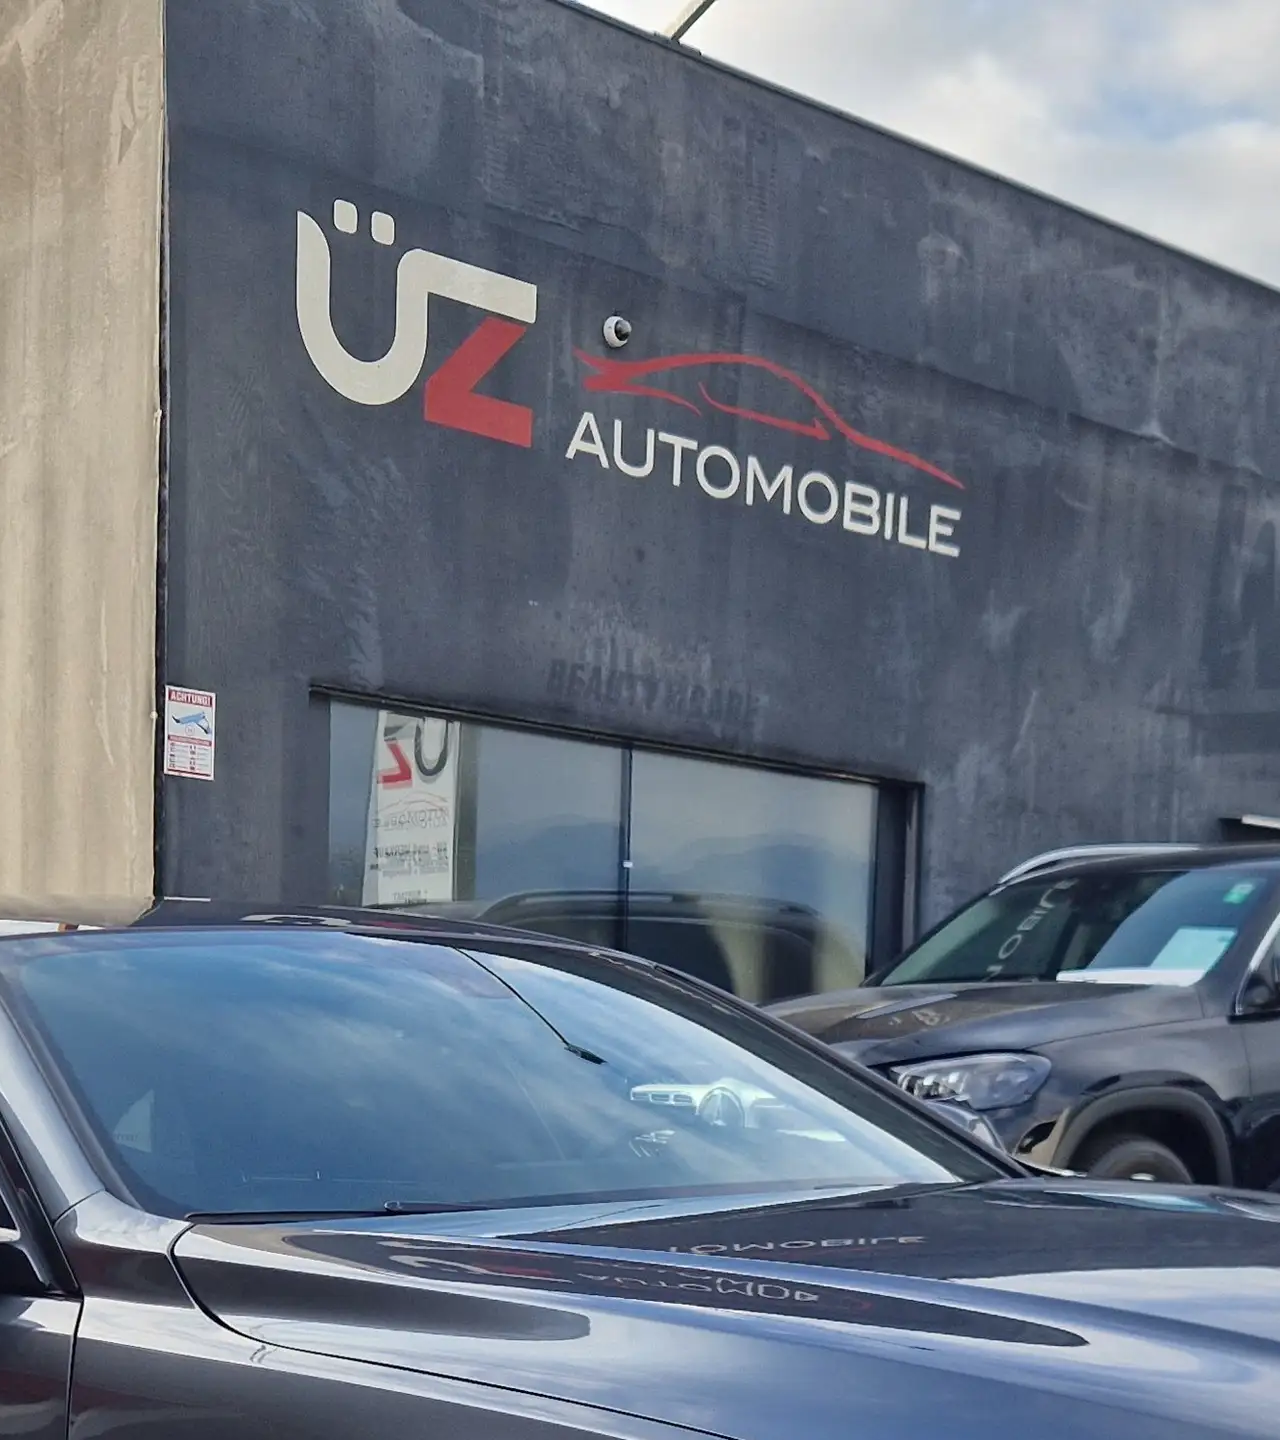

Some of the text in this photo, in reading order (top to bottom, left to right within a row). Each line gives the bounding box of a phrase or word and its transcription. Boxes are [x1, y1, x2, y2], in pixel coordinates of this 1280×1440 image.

[296, 199, 538, 448] ÜZ
[565, 411, 962, 558] AUTOMOBILE
[170, 691, 211, 706] ACHTUNG!
